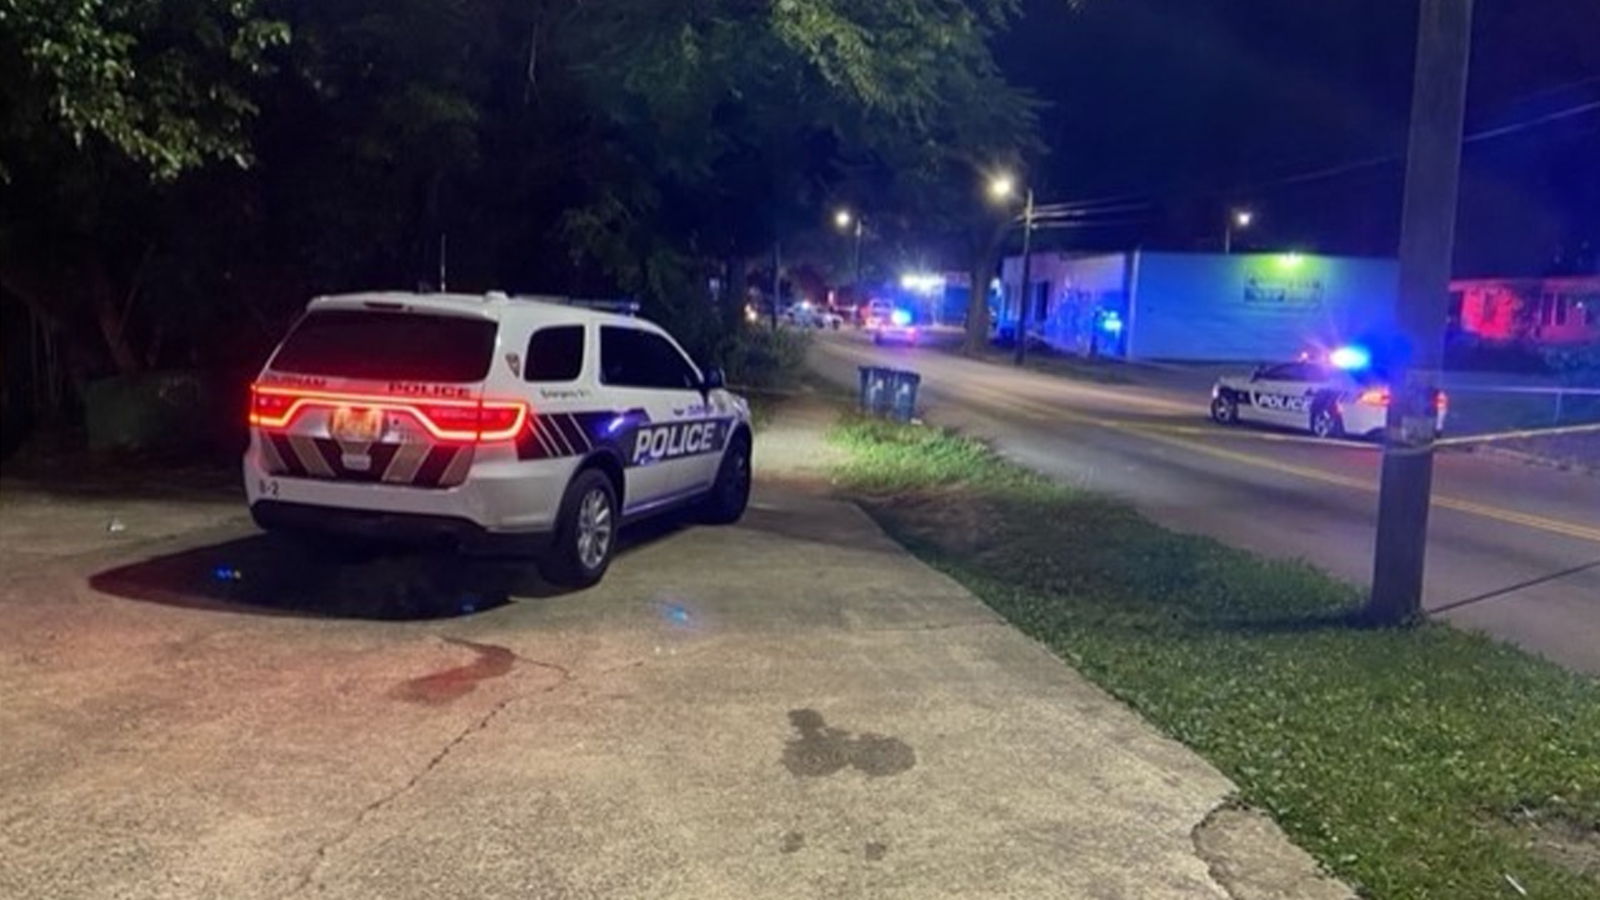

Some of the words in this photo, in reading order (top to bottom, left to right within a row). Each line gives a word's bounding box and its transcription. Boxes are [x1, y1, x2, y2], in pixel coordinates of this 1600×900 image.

[388, 382, 470, 399] POLICE
[1257, 394, 1312, 413] POLICE
[633, 422, 716, 462] POLICE
